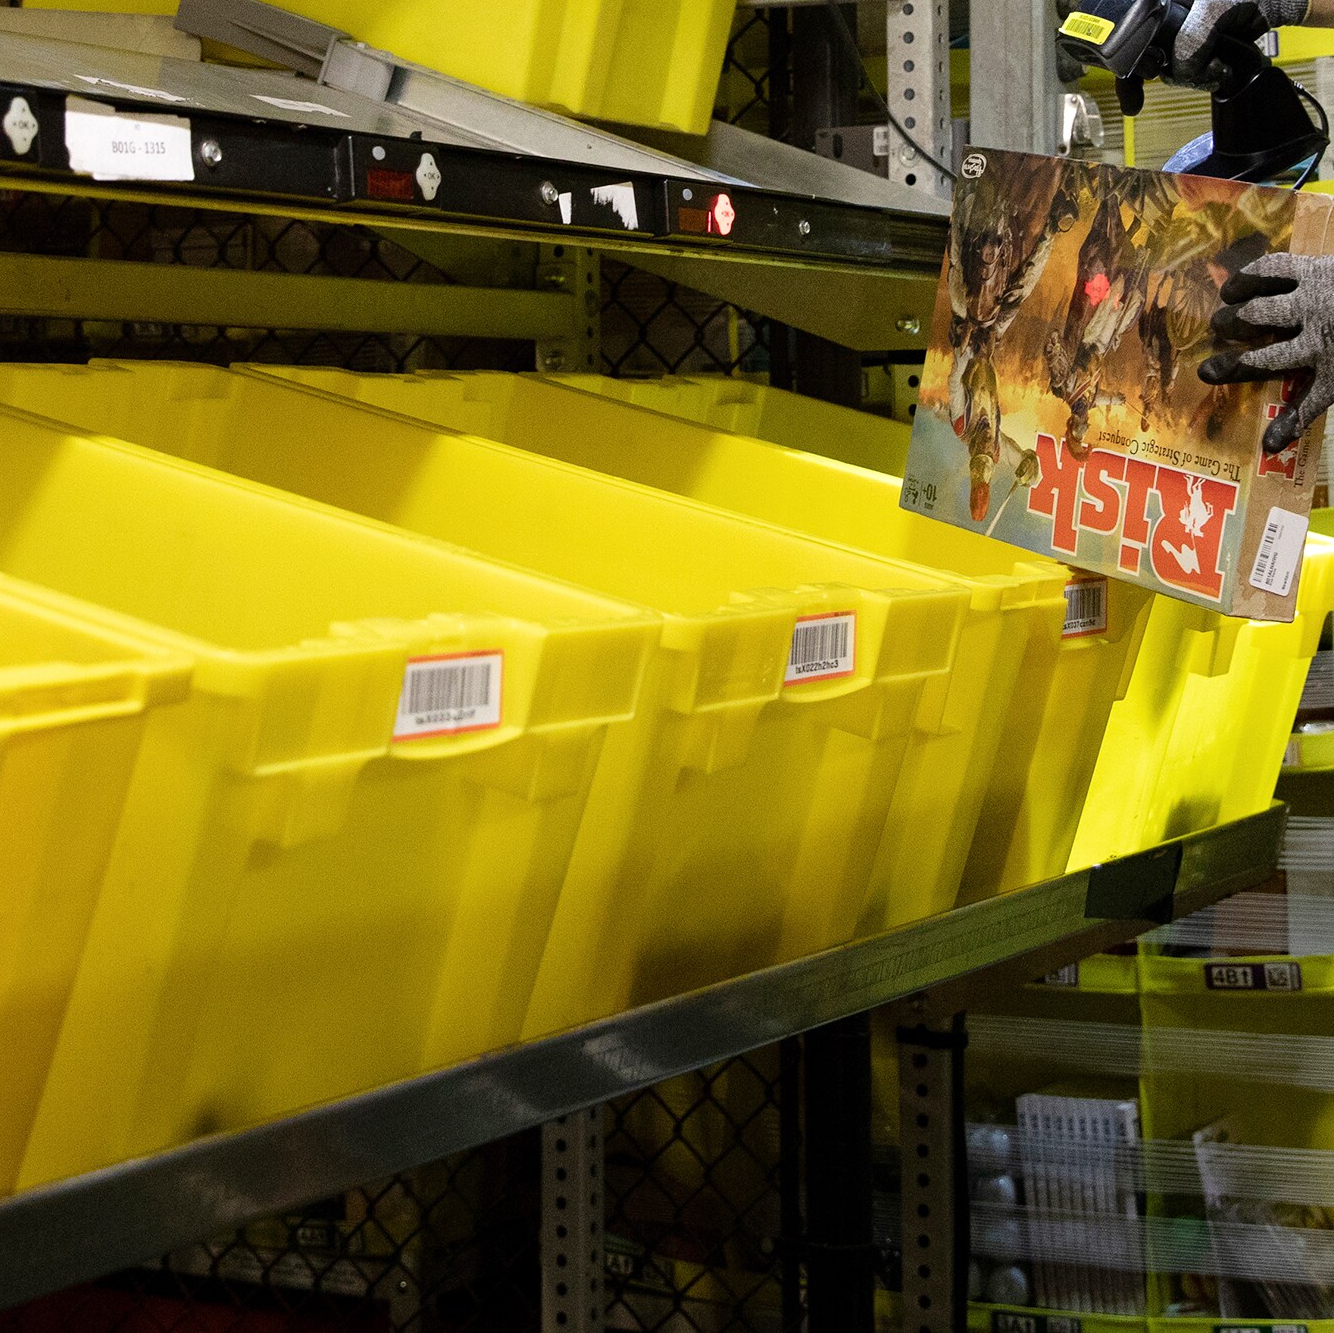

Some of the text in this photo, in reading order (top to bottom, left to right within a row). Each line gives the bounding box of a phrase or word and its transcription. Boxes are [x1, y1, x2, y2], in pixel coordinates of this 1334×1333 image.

[112, 141, 137, 155] B01G
[144, 141, 167, 155] 1315
[1098, 430, 1242, 483] The Game of Strategic Conquest
[1293, 470, 1305, 488] The
[922, 483, 937, 503] 10+
